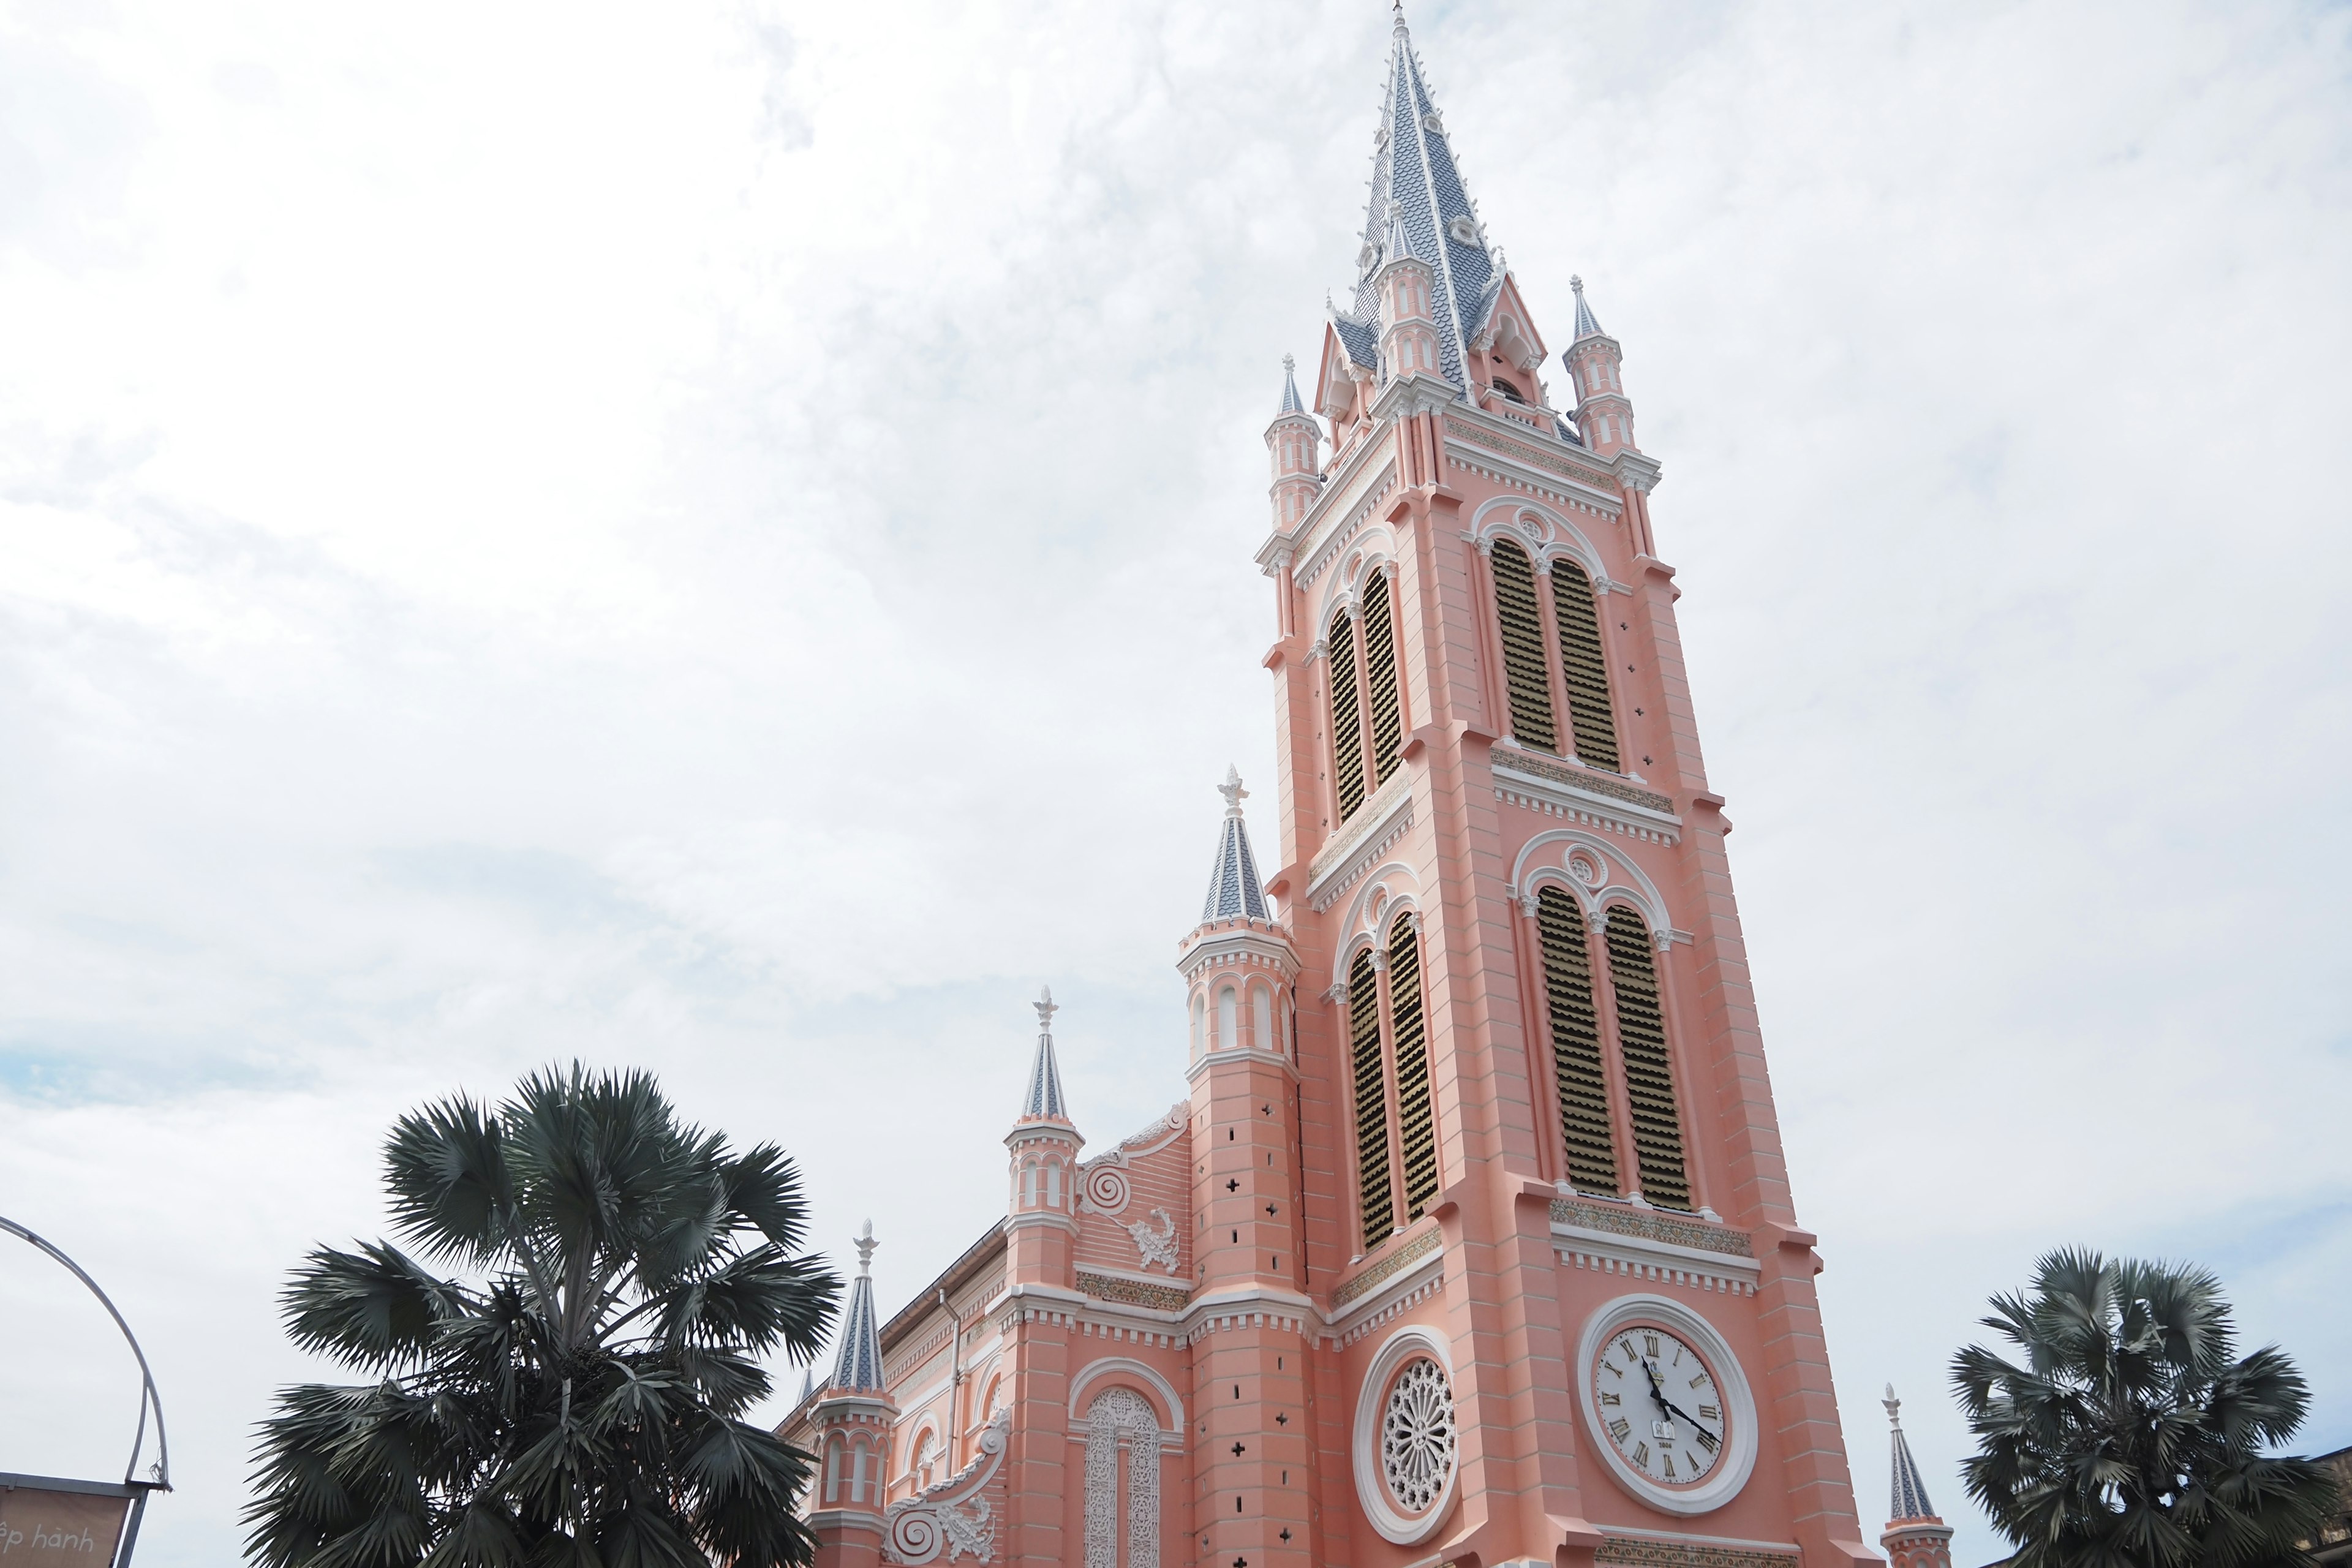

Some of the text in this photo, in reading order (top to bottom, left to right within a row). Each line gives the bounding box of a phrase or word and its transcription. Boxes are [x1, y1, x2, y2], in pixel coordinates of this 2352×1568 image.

[1619, 1338, 1638, 1362] XI
[1643, 1335, 1660, 1358] XII
[1672, 1348, 1683, 1366] I
[1604, 1360, 1623, 1379] X
[1689, 1373, 1706, 1389] II
[1602, 1391, 1621, 1406] IX
[1698, 1404, 1717, 1420] III
[1632, 1441, 1649, 1468] VII
[1663, 1453, 1676, 1477] VI
[1686, 1450, 1700, 1472] V
[31, 1523, 94, 1552] hành
